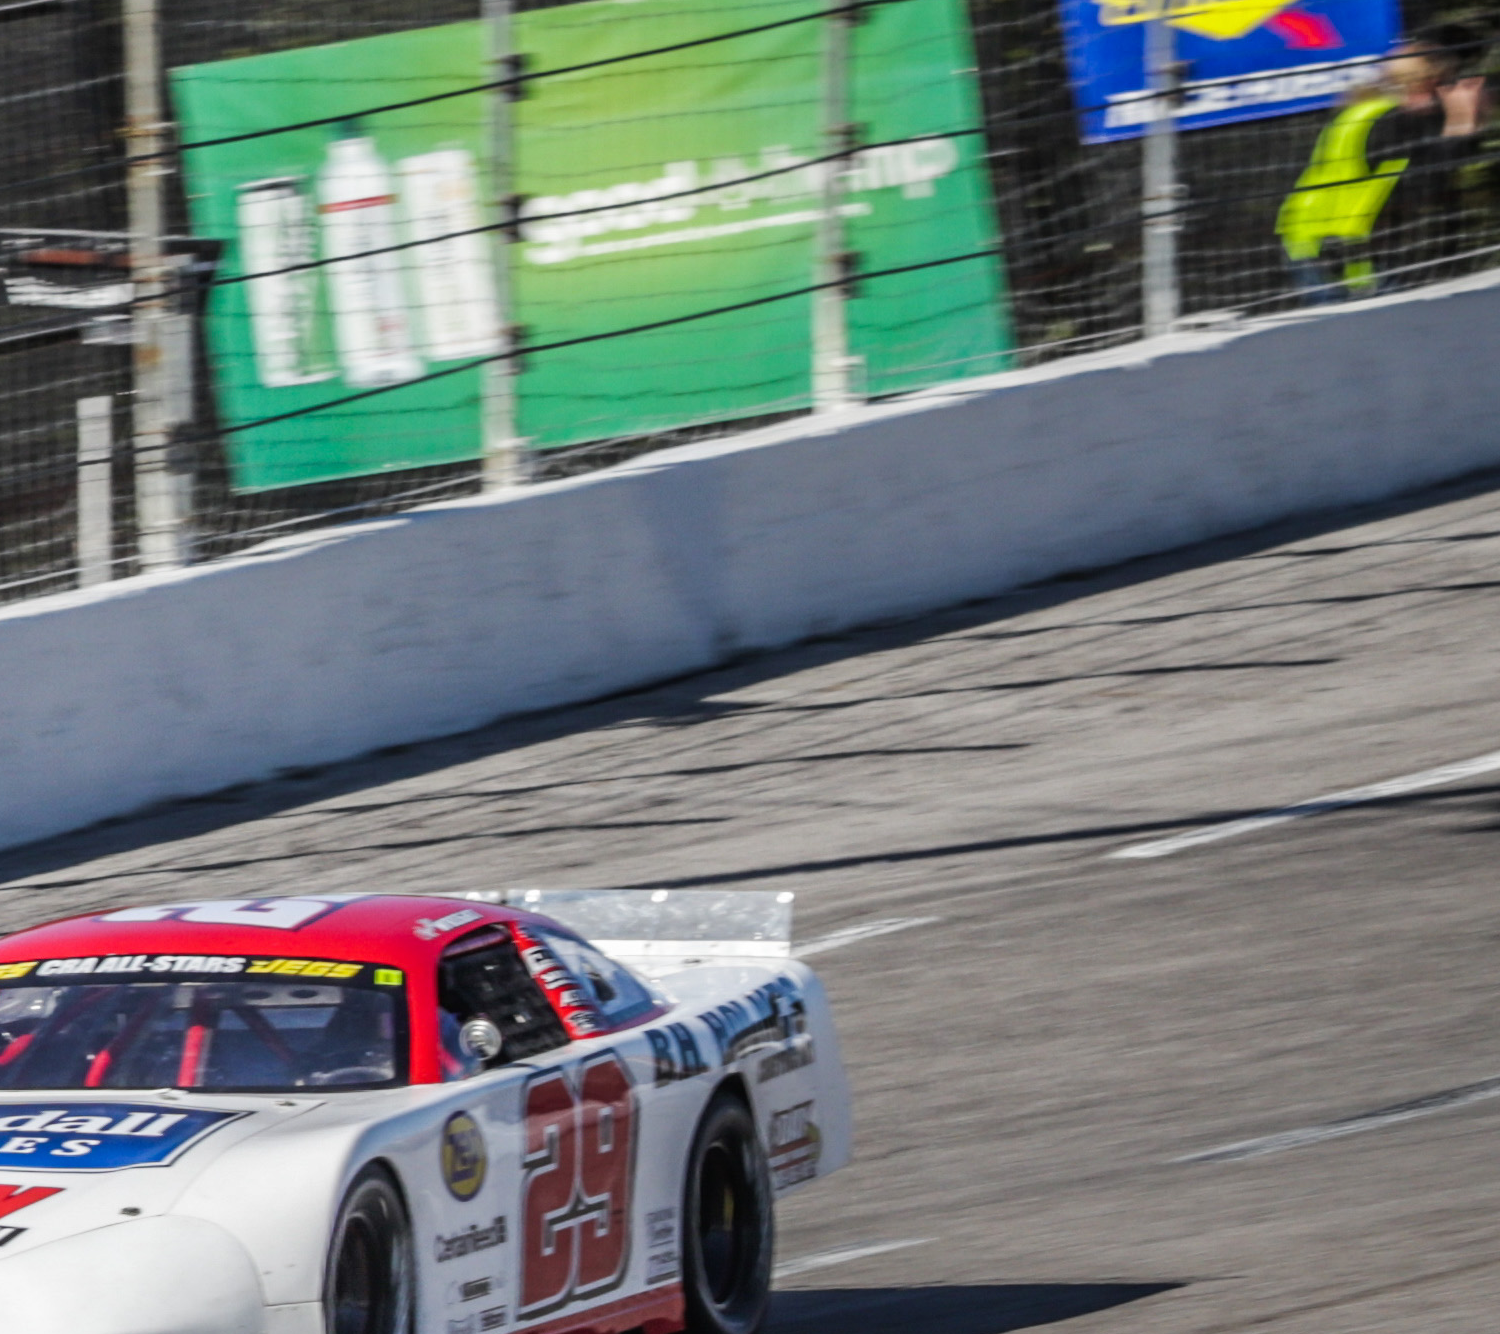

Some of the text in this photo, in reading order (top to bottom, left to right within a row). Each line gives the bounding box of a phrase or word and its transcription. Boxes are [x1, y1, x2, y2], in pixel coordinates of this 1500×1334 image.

[36, 957, 98, 977] CRA
[102, 953, 245, 974] ALL-STARS
[246, 960, 364, 978] JEGS
[519, 1053, 637, 1321] 29
